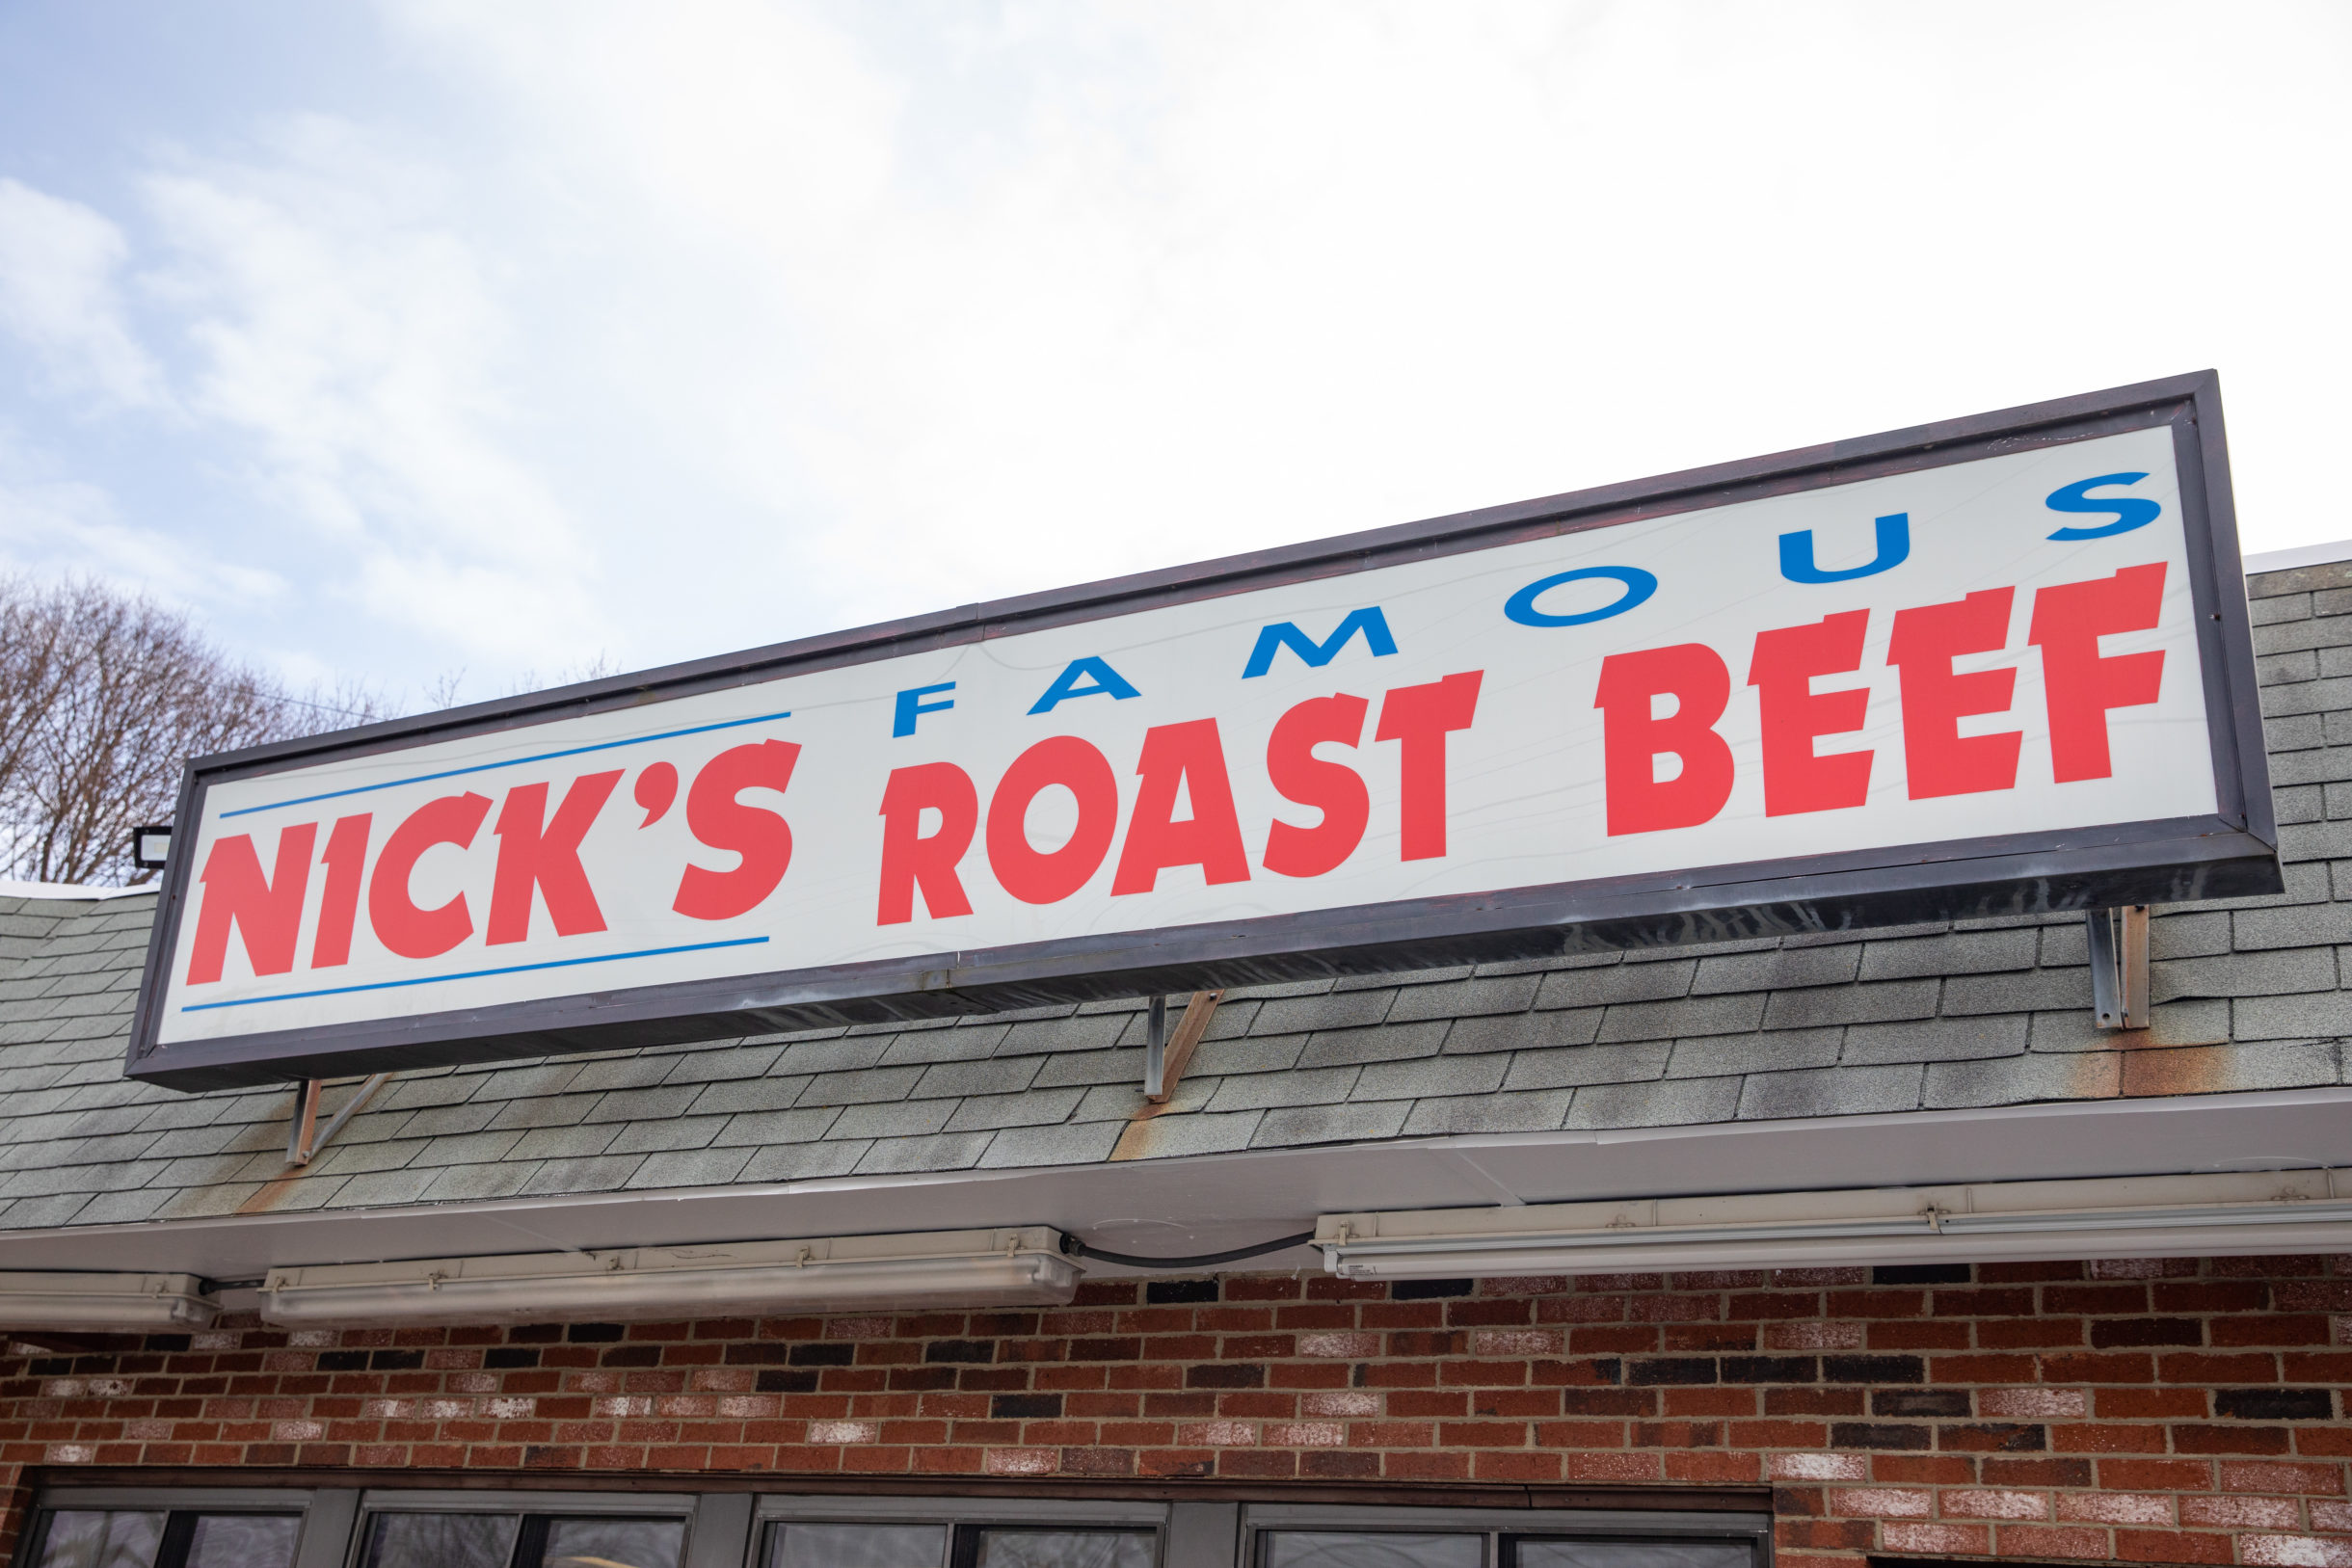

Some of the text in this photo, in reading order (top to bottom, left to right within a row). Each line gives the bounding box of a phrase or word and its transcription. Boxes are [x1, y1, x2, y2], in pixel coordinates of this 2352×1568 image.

[186, 561, 2168, 986] NICK'S ROAST BEEF
[893, 471, 2161, 738] FAMOUS
